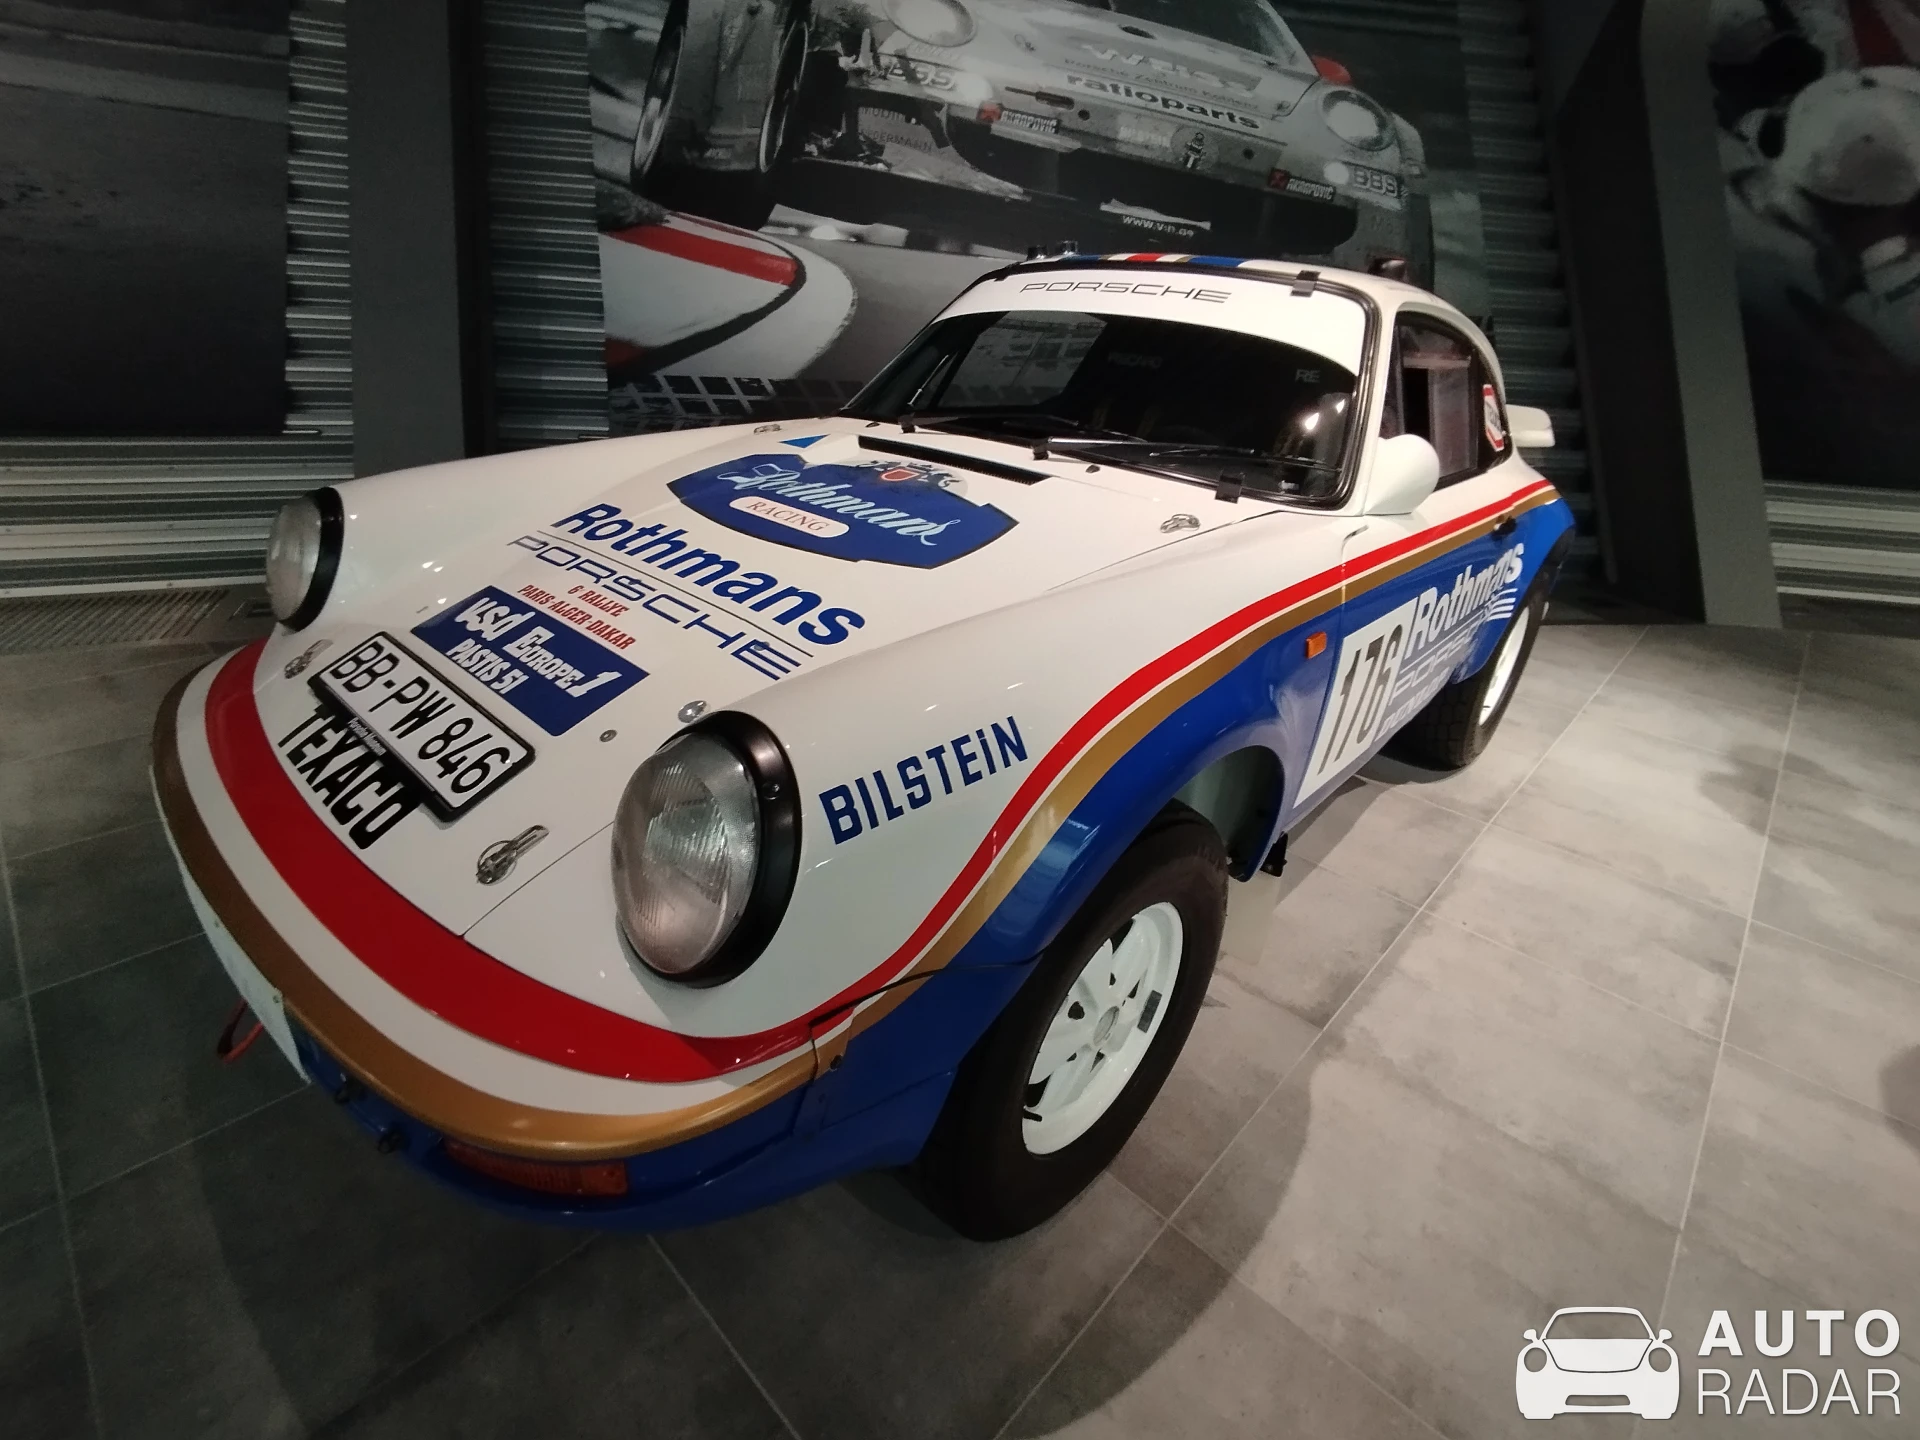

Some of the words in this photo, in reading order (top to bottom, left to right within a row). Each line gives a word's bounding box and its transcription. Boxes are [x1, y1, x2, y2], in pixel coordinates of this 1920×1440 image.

[1066, 74, 1260, 130] ratioparts
[1353, 165, 1398, 198] BBS
[1019, 280, 1232, 304] PORSCHE
[716, 463, 961, 546] Rothmans
[745, 501, 831, 532] RACING
[550, 503, 866, 645] Rothmans
[577, 590, 631, 617] RALLYE
[1404, 542, 1525, 661] Rothmans
[506, 535, 802, 681] PORSCHE
[445, 638, 512, 686] PASTIS
[494, 668, 530, 694] 51
[565, 671, 622, 698] 1
[1316, 624, 1403, 776] 176
[278, 702, 421, 850] TEXACO
[418, 717, 510, 794] 846
